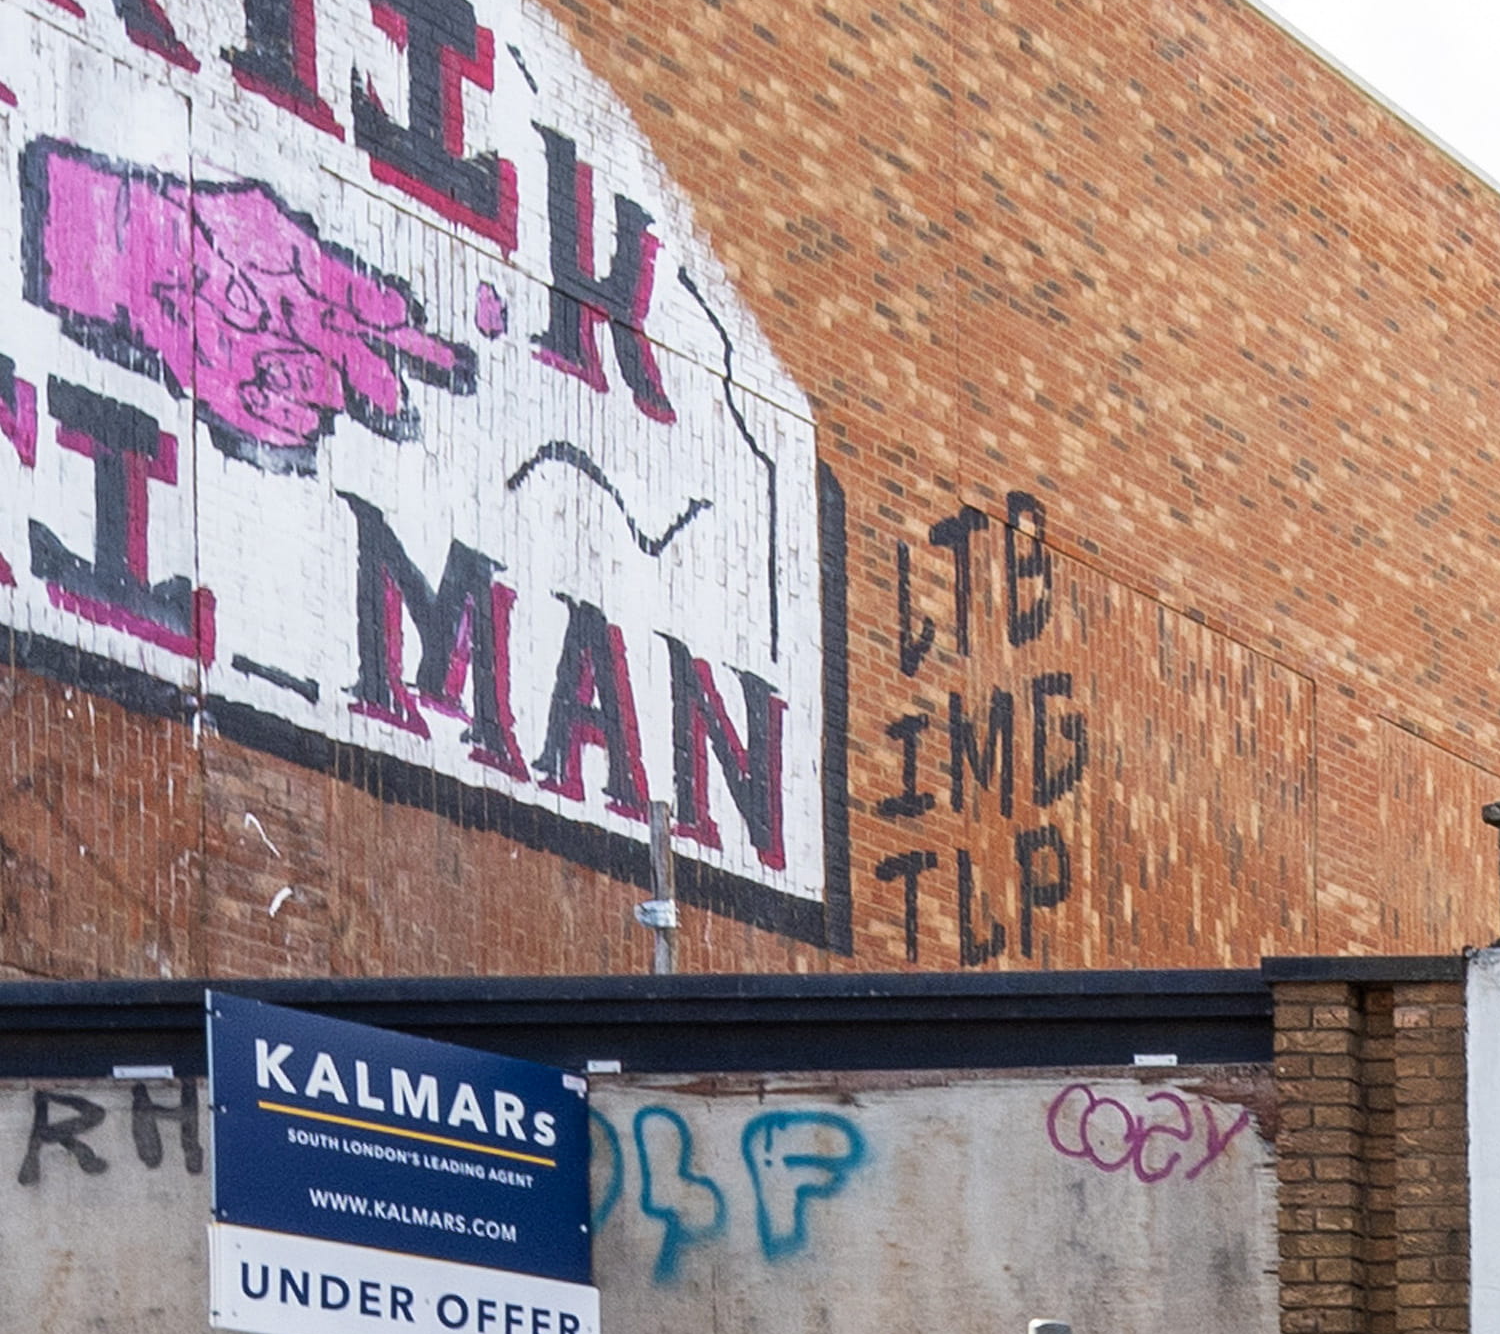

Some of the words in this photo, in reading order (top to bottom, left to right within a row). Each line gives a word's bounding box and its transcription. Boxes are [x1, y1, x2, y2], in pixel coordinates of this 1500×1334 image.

[336, 490, 786, 869] MAN
[287, 1127, 339, 1151] SOUTH
[342, 1135, 421, 1168] LONDON'S
[423, 1153, 486, 1180] LEADING
[488, 1166, 534, 1189] AGENT
[309, 1187, 517, 1243] WWW.KALMARS.COM
[240, 1261, 415, 1323] UNDER
